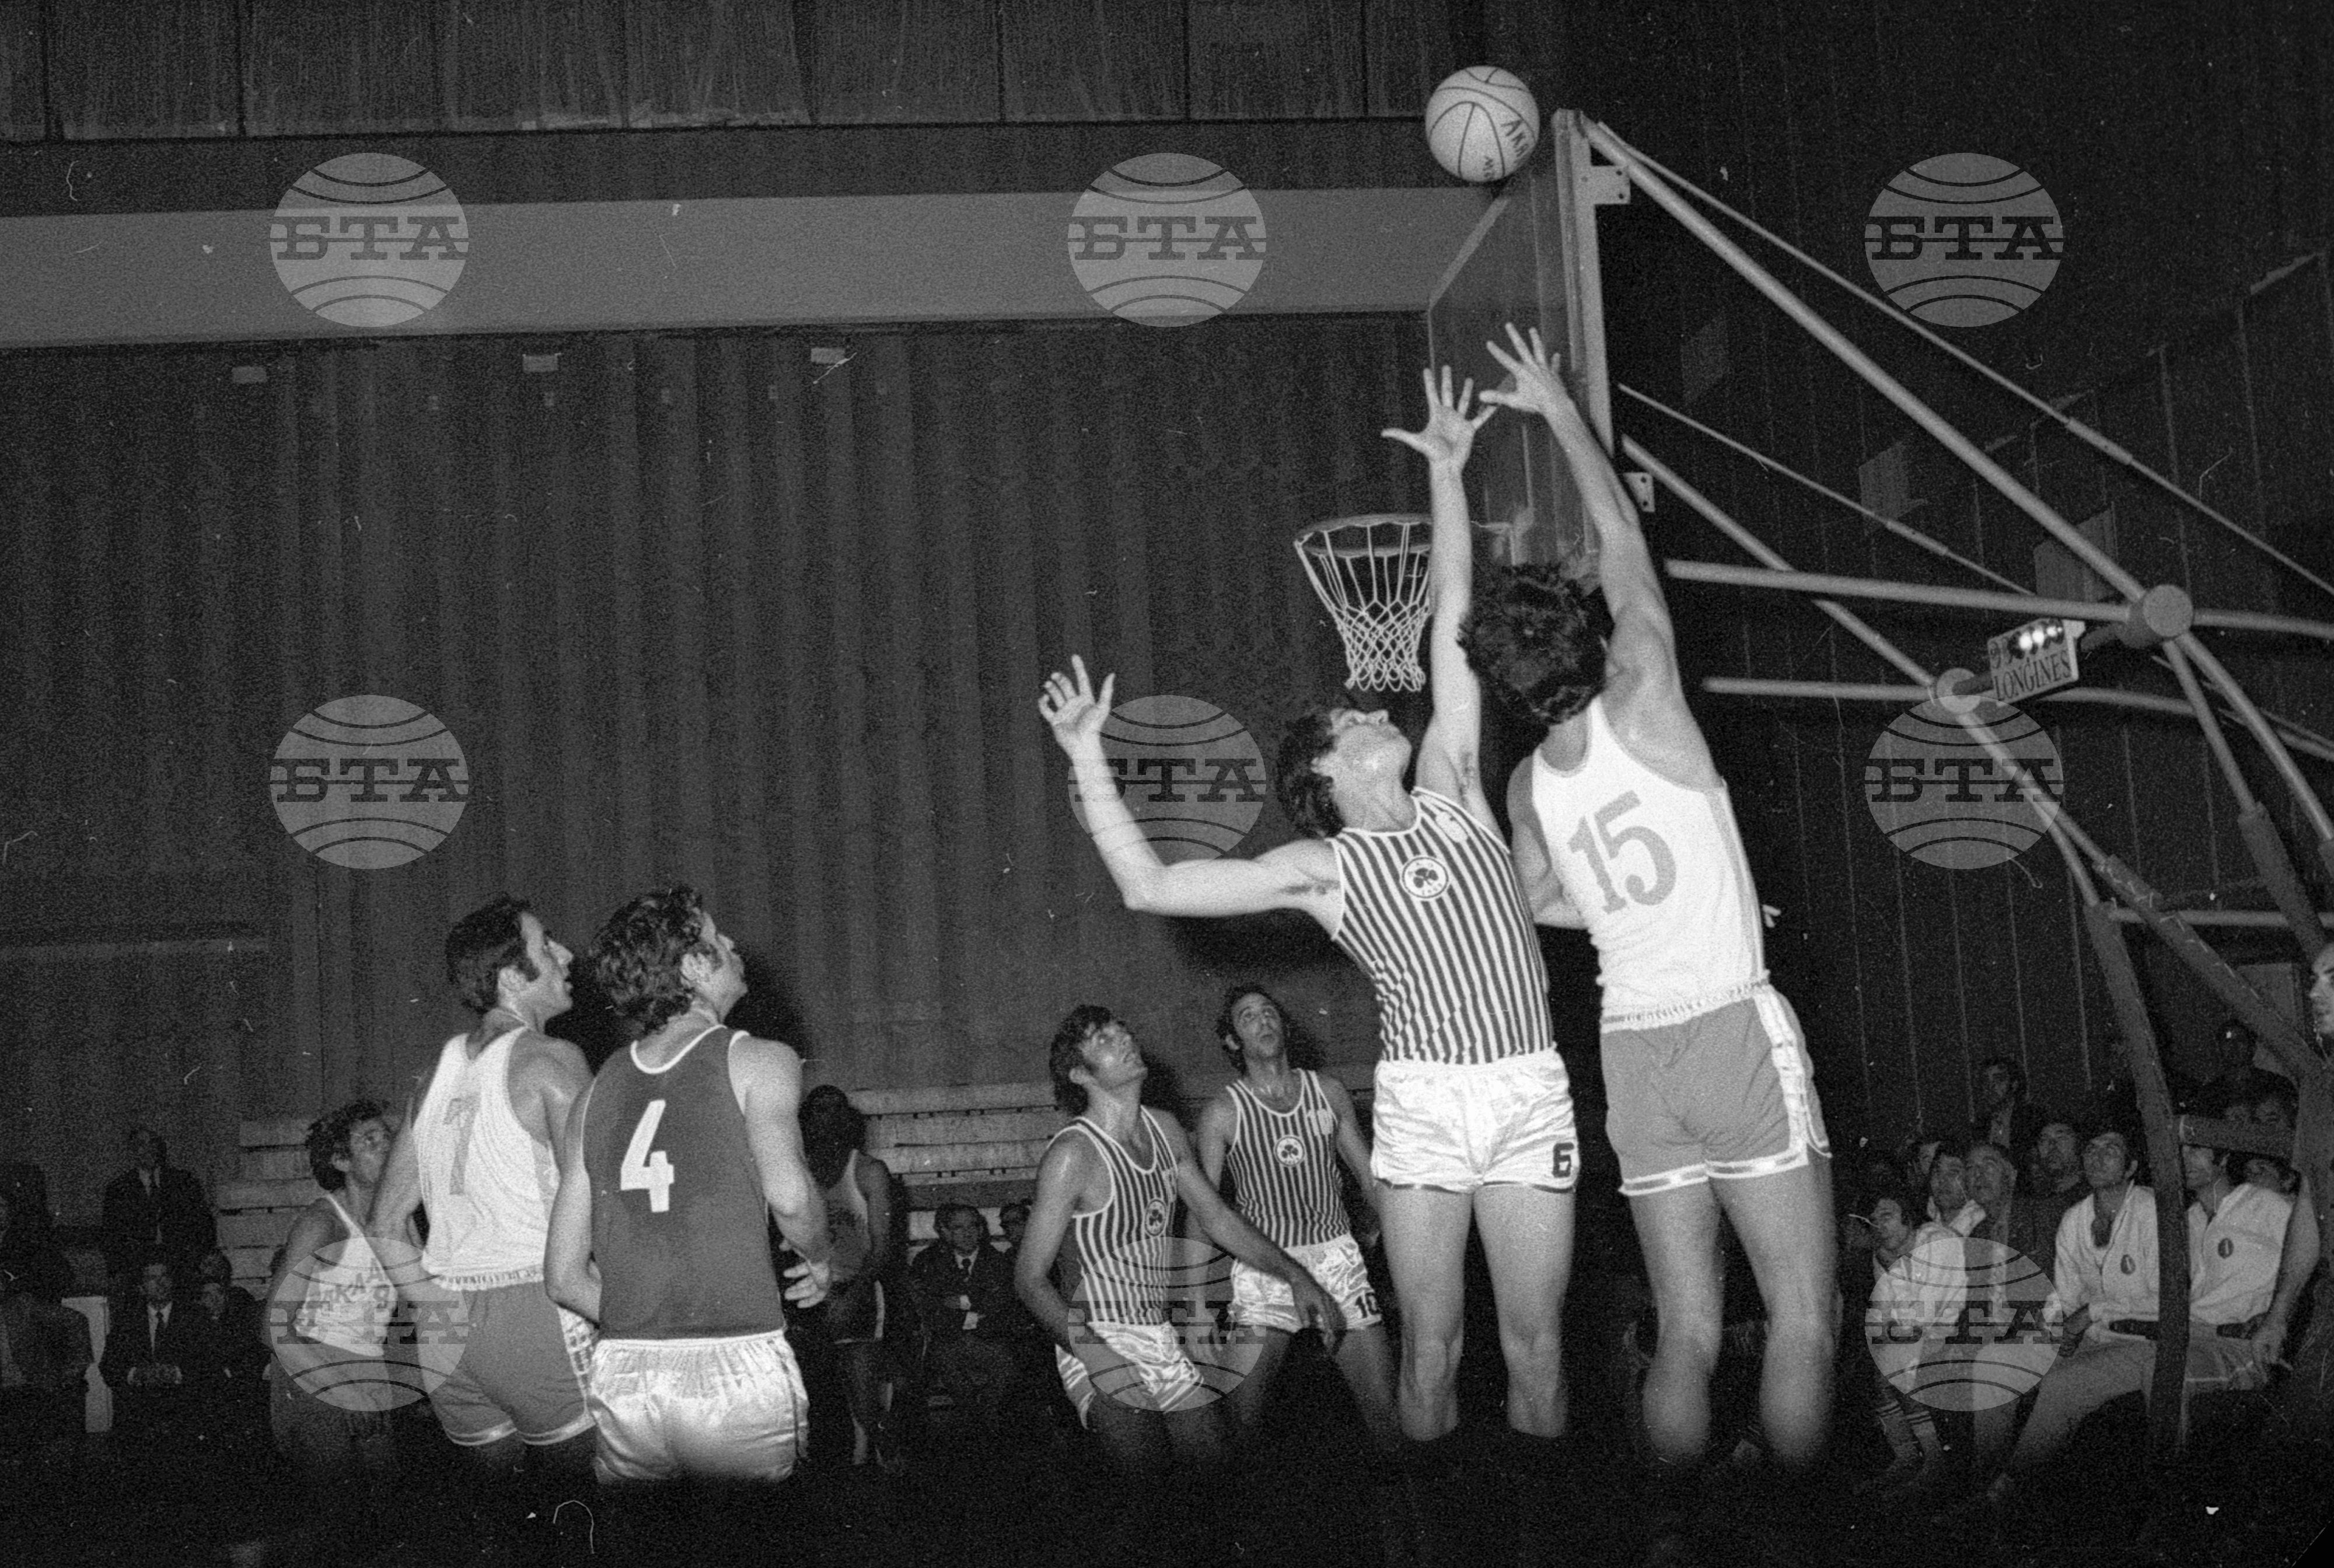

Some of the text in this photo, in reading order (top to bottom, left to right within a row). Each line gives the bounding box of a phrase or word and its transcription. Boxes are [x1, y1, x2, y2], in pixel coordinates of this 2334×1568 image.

[1994, 649, 2072, 701] LONGINES
[1567, 790, 1676, 914] 15
[620, 1099, 674, 1213] 4
[1552, 1141, 1575, 1178] 6
[1355, 1291, 1382, 1319] 10
